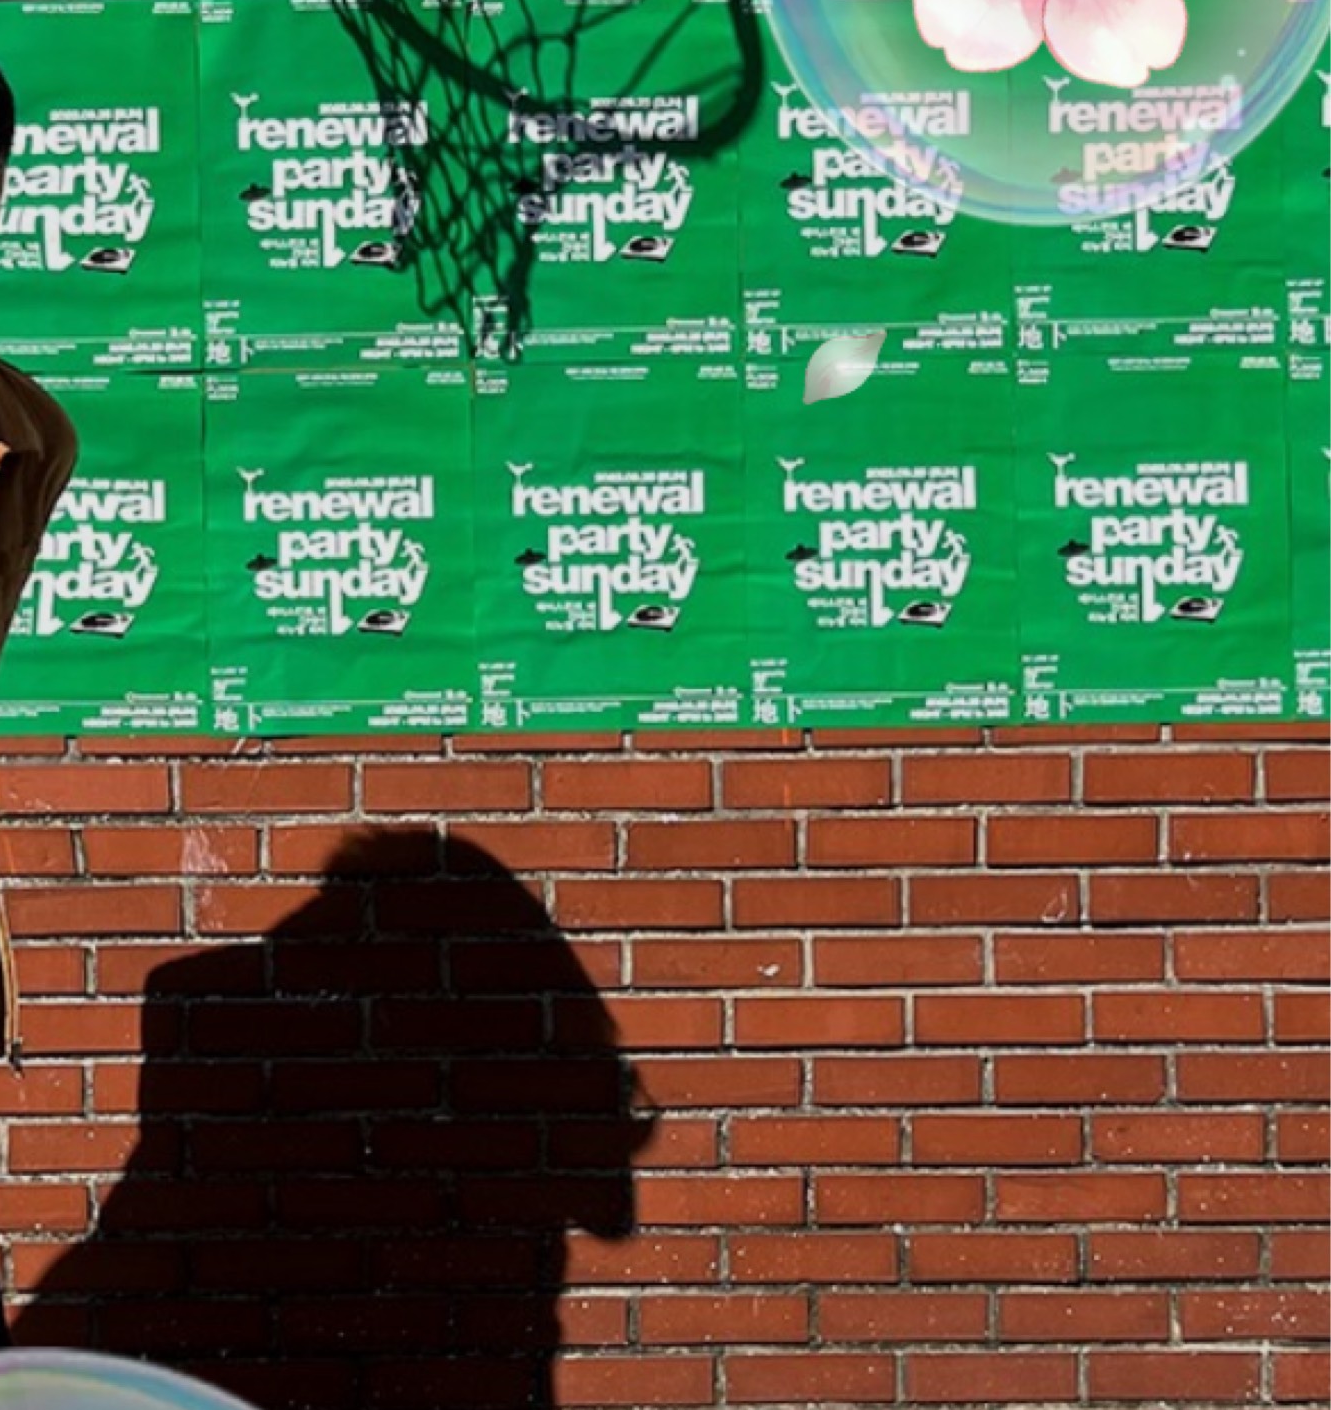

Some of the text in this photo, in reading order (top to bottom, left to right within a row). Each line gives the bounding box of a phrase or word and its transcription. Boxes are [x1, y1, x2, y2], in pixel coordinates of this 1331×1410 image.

[11, 107, 160, 154] newal
[237, 102, 429, 150] renewal
[507, 96, 699, 143] renewal
[777, 91, 969, 138] renewal
[1048, 86, 1243, 133] renewal
[272, 150, 397, 197] party
[542, 145, 667, 191] party
[812, 140, 936, 185] party
[1083, 135, 1207, 181] party
[247, 191, 422, 268] sunday
[517, 184, 693, 261] sunday
[788, 180, 963, 257] sunday
[1058, 176, 1235, 252] sunday
[50, 480, 166, 521] ewal
[243, 475, 435, 521] renewal
[513, 470, 705, 516] renewal
[784, 466, 976, 512] renewal
[1054, 461, 1249, 507] renewal
[36, 525, 132, 568] rty
[278, 522, 403, 567] party
[547, 518, 673, 563] party
[819, 514, 945, 558] party
[1090, 508, 1217, 554] party
[21, 561, 158, 634] nday
[253, 560, 429, 636] sunday
[522, 555, 699, 631] sunday
[794, 551, 971, 627] sunday
[1065, 546, 1243, 623] sunday
